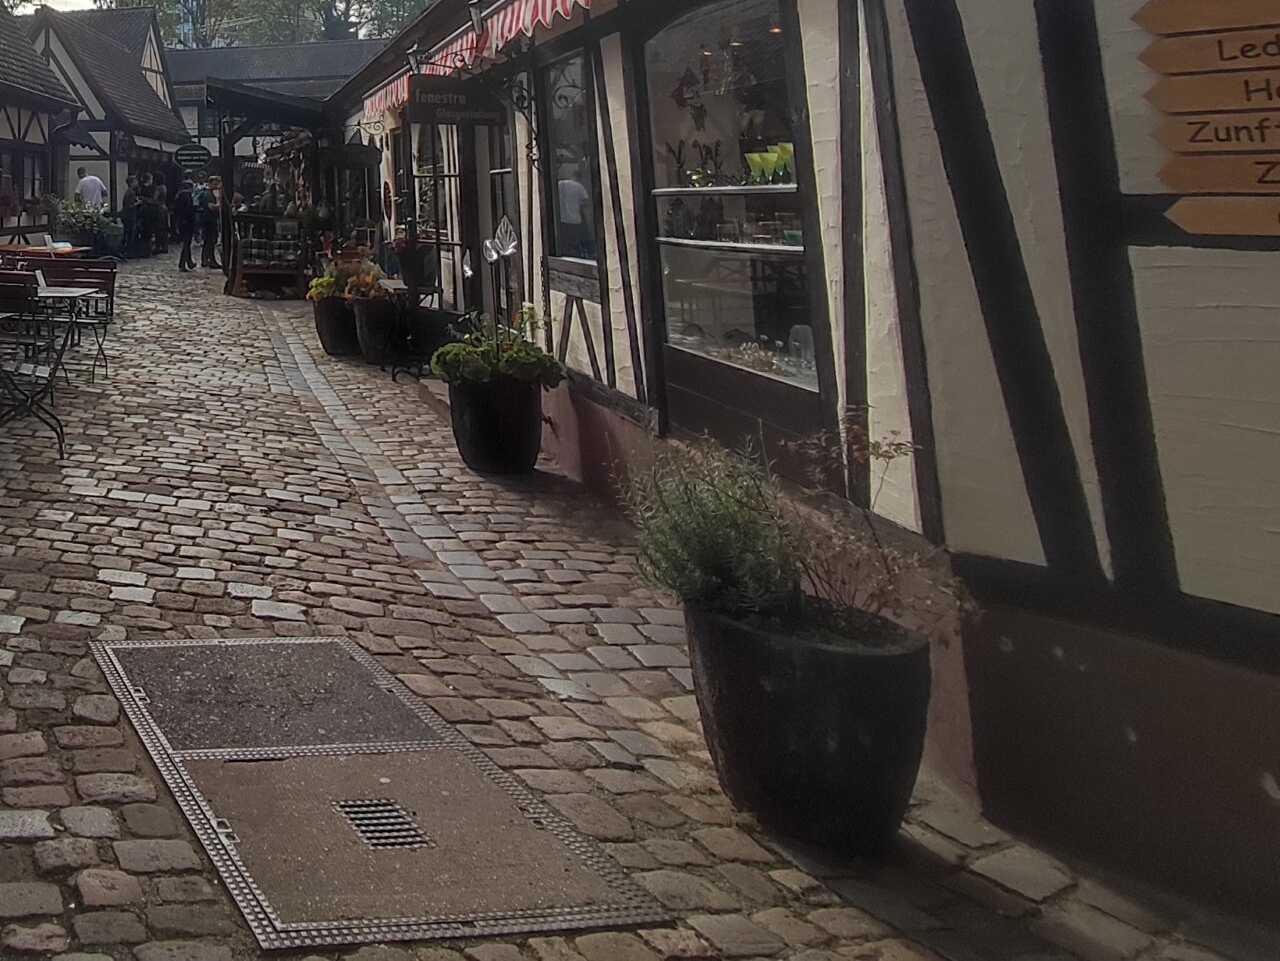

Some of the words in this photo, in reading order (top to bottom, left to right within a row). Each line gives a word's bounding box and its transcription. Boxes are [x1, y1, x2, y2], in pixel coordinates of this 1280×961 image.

[415, 88, 466, 105] fenestra
[1244, 78, 1280, 103] H
[1186, 118, 1280, 143] Zunf
